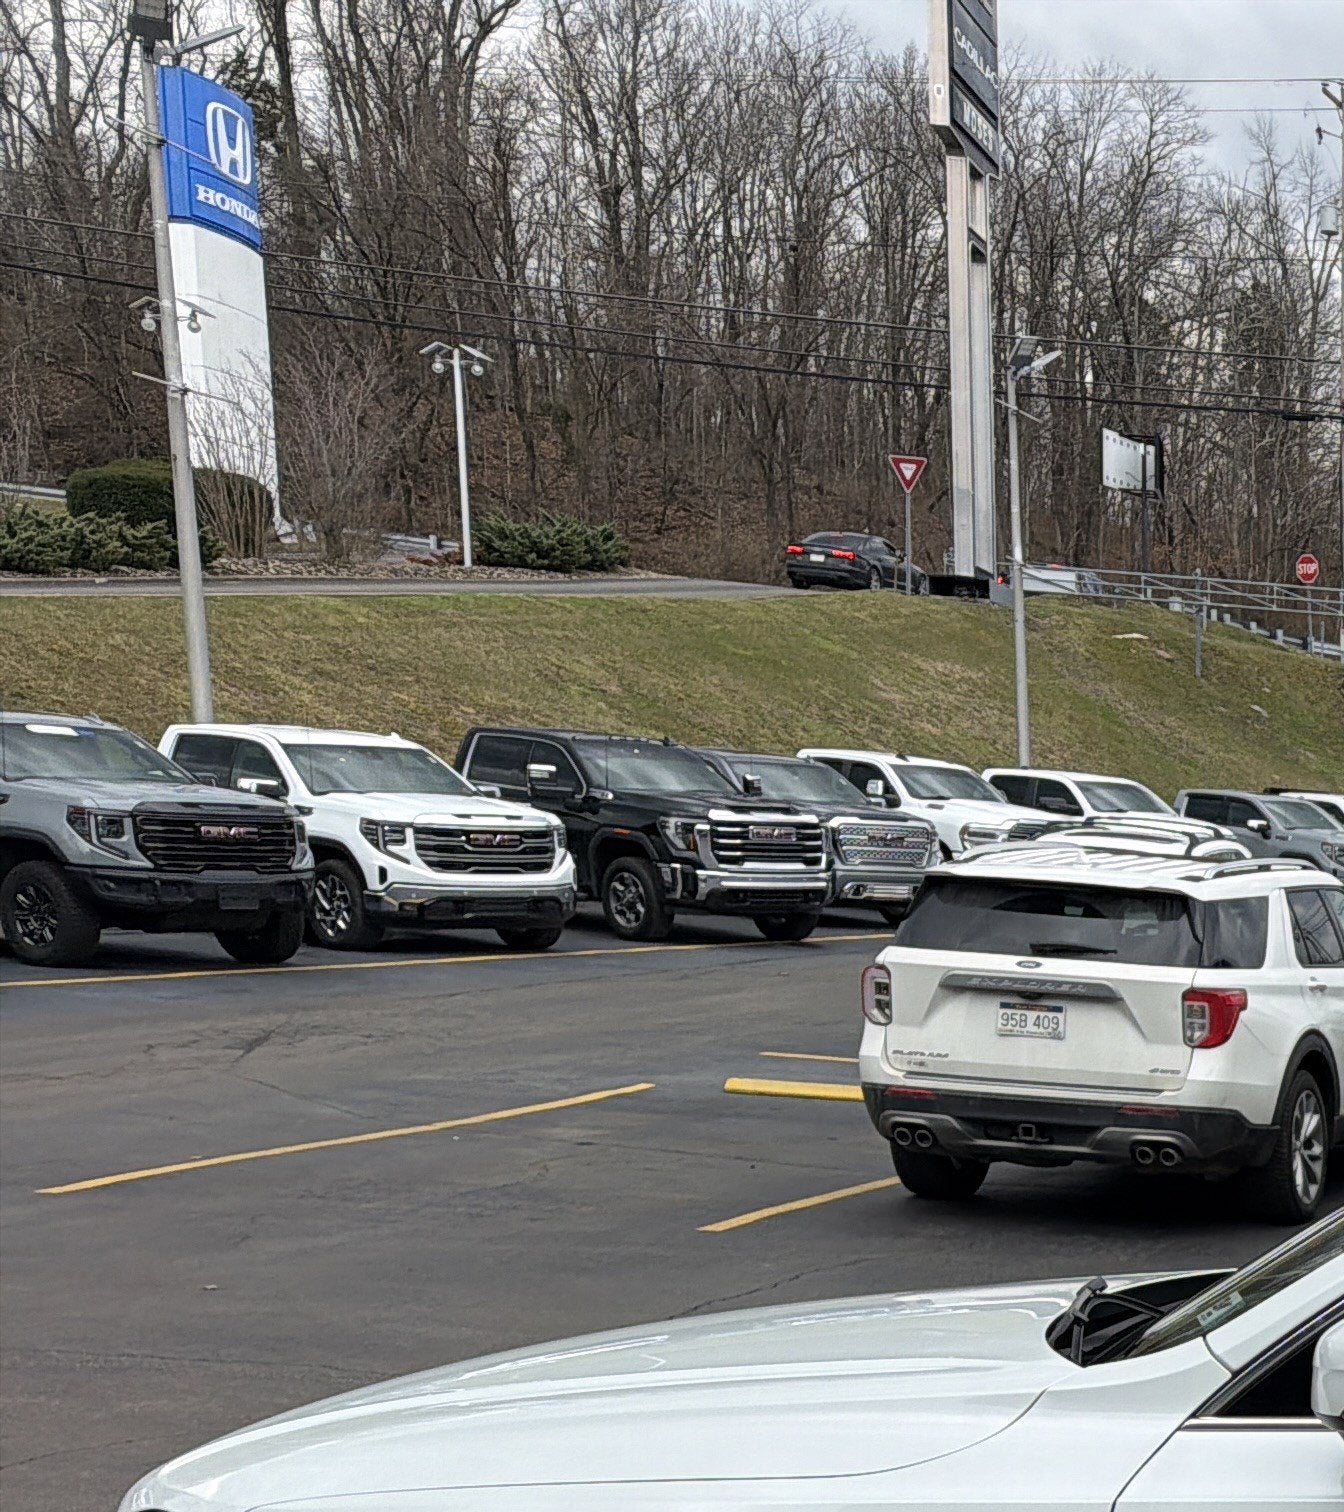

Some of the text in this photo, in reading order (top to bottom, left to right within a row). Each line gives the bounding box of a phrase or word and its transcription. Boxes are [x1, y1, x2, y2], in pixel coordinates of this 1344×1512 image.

[954, 26, 1000, 90] CADILLAC
[195, 183, 260, 230] HONDA
[1298, 563, 1318, 575] STOP
[1033, 1014, 1060, 1032] 409
